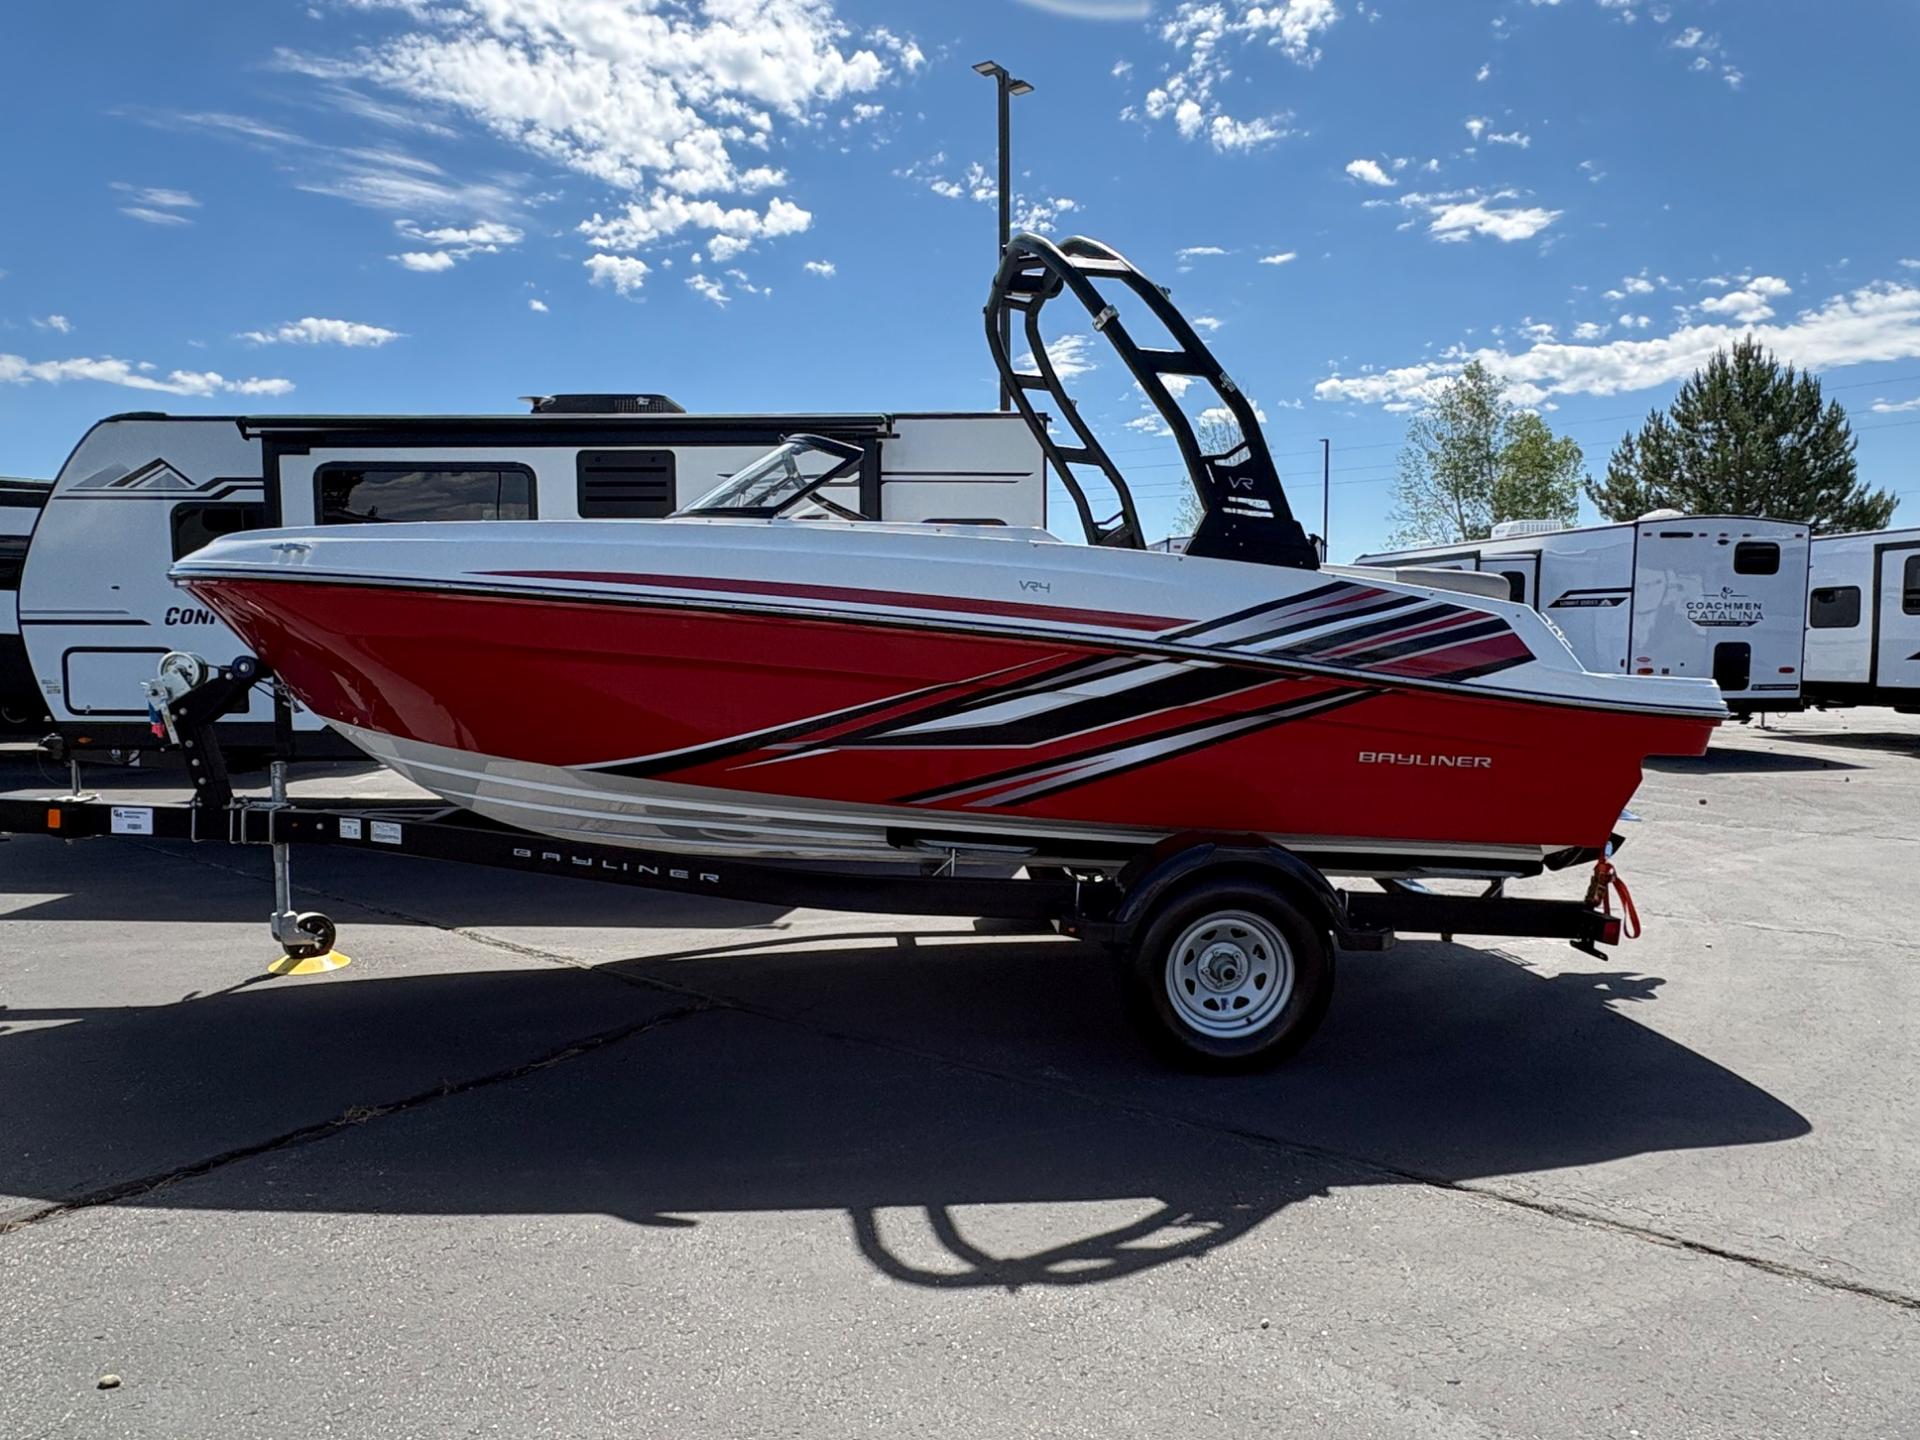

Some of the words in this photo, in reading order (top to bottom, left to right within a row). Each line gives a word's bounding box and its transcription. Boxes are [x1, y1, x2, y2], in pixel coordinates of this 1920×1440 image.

[1228, 475, 1254, 490] VR
[1019, 579, 1051, 593] VR4
[1686, 602, 1762, 610] COACHMEN
[1687, 610, 1764, 620] CATALINA
[1358, 751, 1493, 768] BAYLINER
[513, 848, 720, 883] BAYLINER
